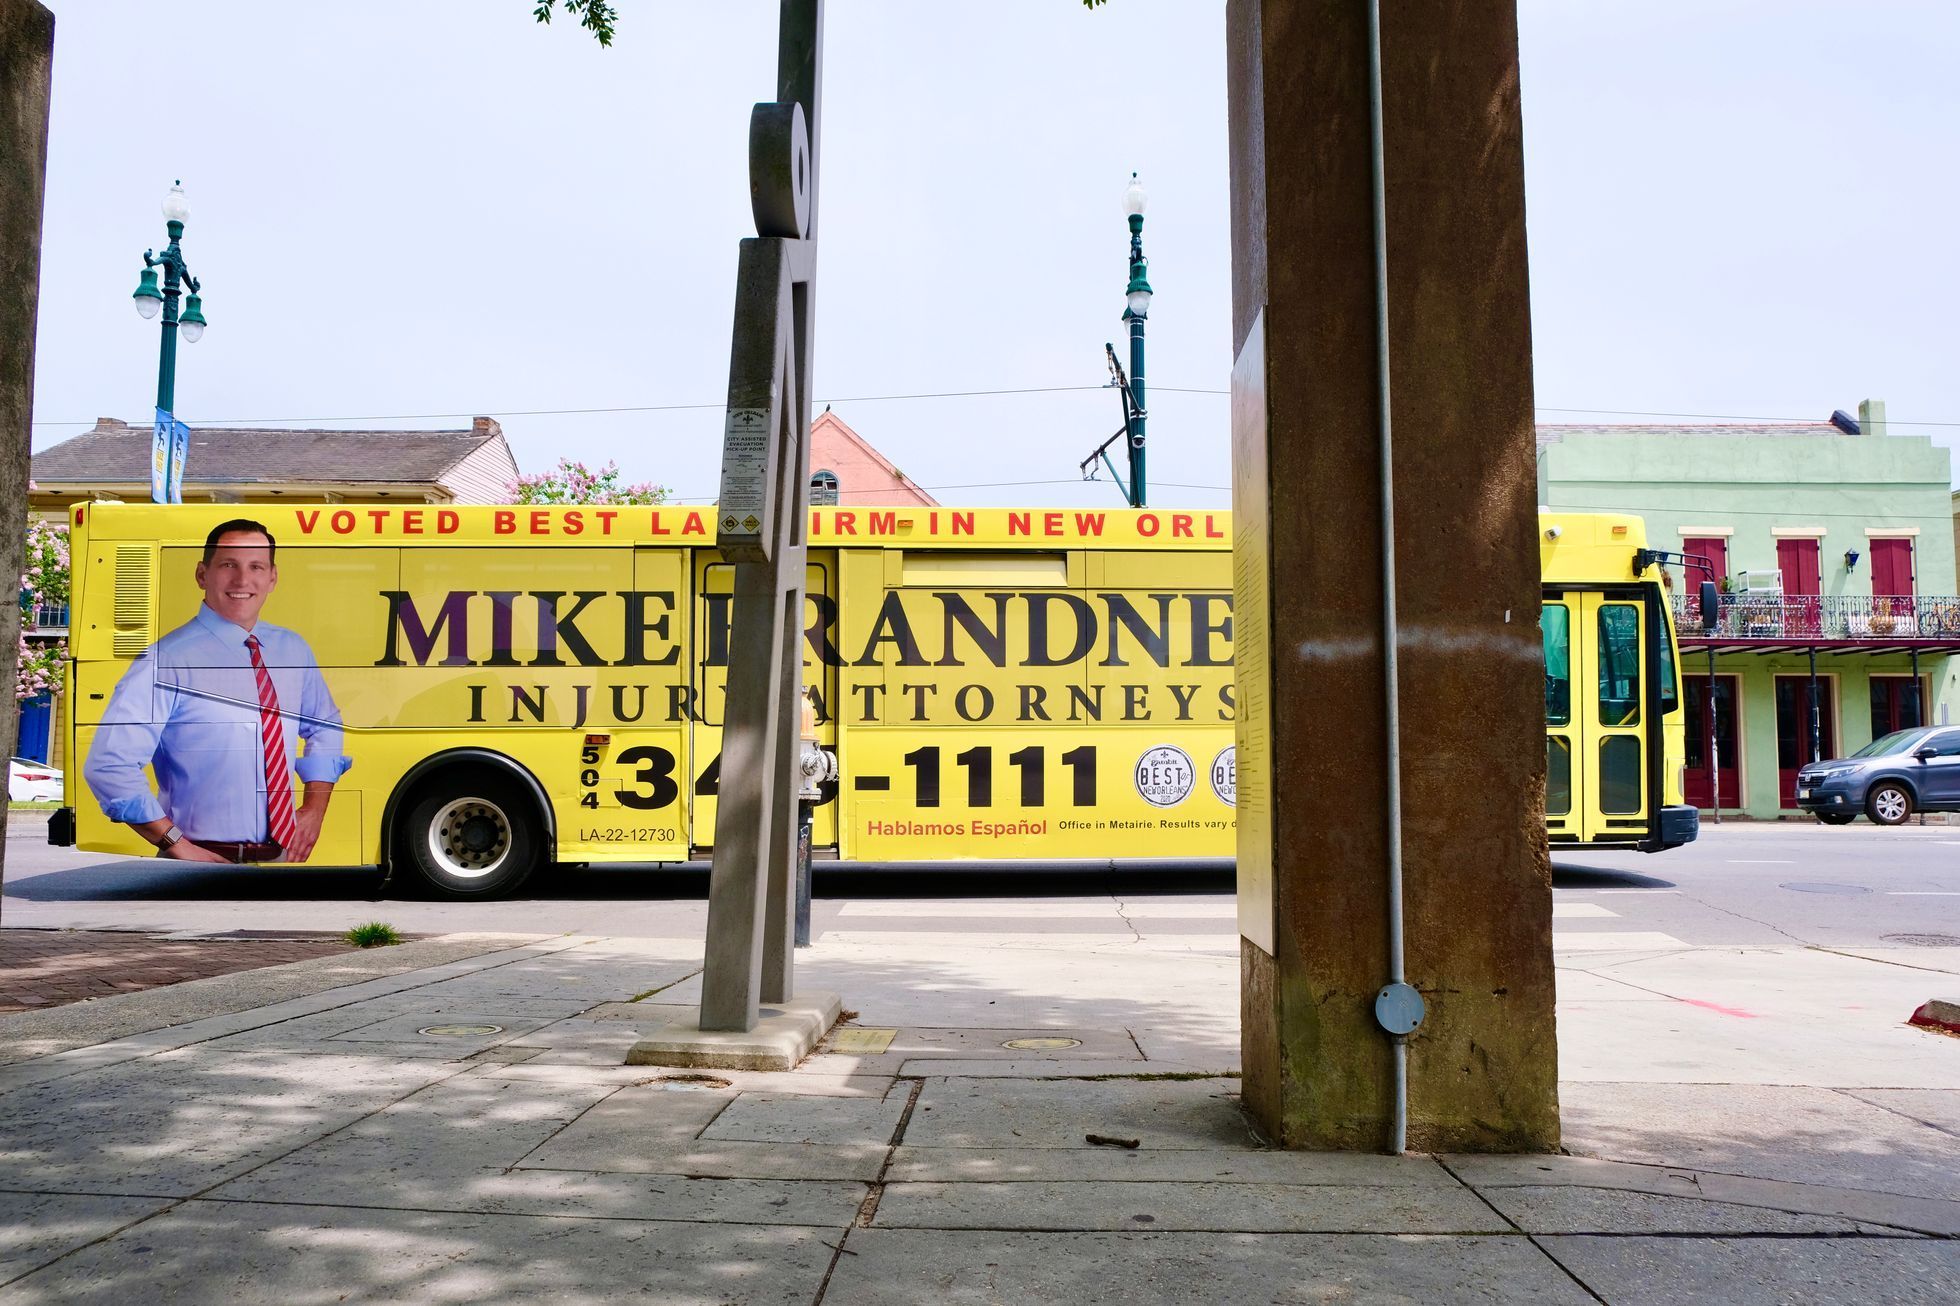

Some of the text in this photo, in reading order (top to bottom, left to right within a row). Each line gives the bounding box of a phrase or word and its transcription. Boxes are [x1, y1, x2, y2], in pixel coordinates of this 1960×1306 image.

[295, 510, 1224, 539] VOTED BEST LA IRM IN NEW ORL
[373, 590, 681, 667] MIKE
[466, 685, 727, 729] INJUR
[1140, 767, 1183, 786] BEST
[1216, 766, 1236, 785] BE
[867, 819, 1047, 839] Hablamos Español
[1059, 820, 1092, 830] Office
[1095, 820, 1105, 829] in
[1109, 819, 1156, 829] Metairie.
[1160, 819, 1201, 829] Results
[1204, 821, 1227, 830] vary
[580, 828, 675, 842] LA-22-12730
